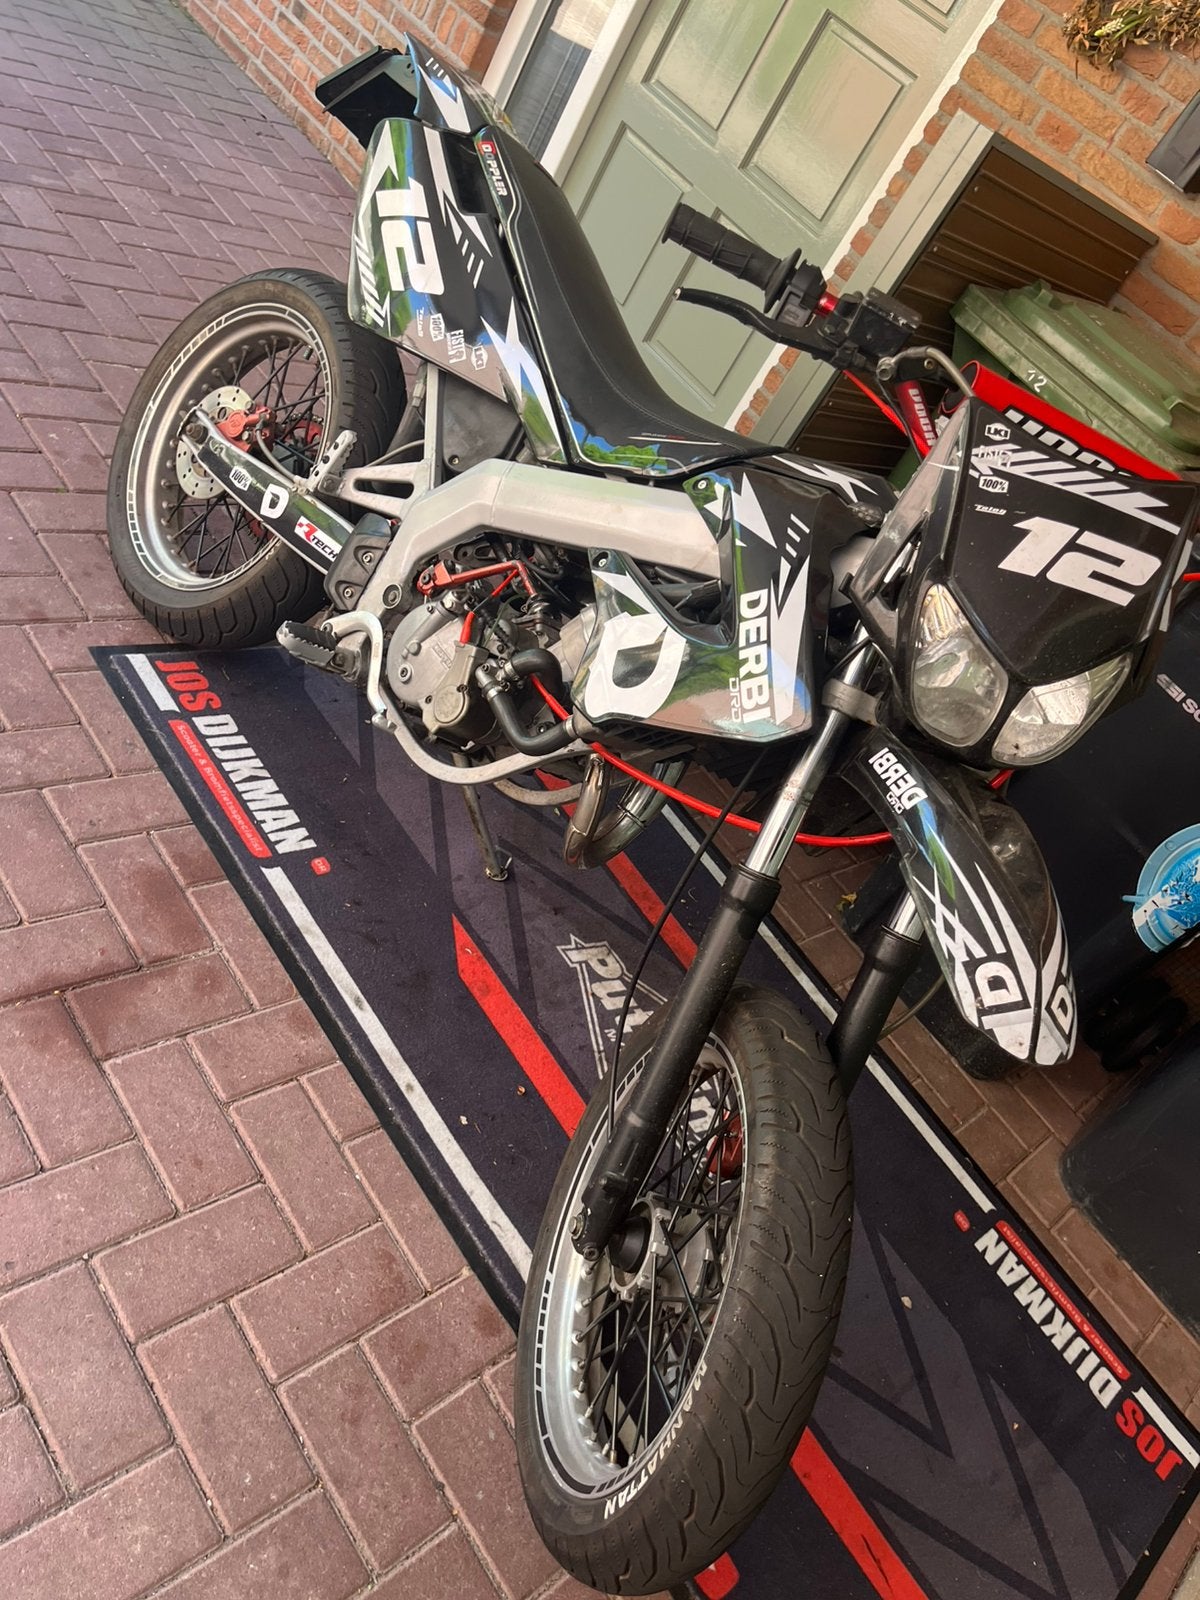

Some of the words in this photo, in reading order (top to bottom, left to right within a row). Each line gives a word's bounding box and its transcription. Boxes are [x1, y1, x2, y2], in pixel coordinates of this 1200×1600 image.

[481, 144, 508, 197] DOPPLER
[375, 177, 445, 296] 12
[230, 469, 249, 489] 100%
[981, 478, 1007, 491] 100%
[997, 516, 1162, 607] 12
[728, 676, 744, 722] DRD
[737, 588, 772, 724] DERBI
[154, 660, 222, 713] JOS
[192, 714, 318, 855] DIJKMAN
[973, 1228, 1123, 1410] DIJKMAN
[1115, 1398, 1184, 1482] JOS
